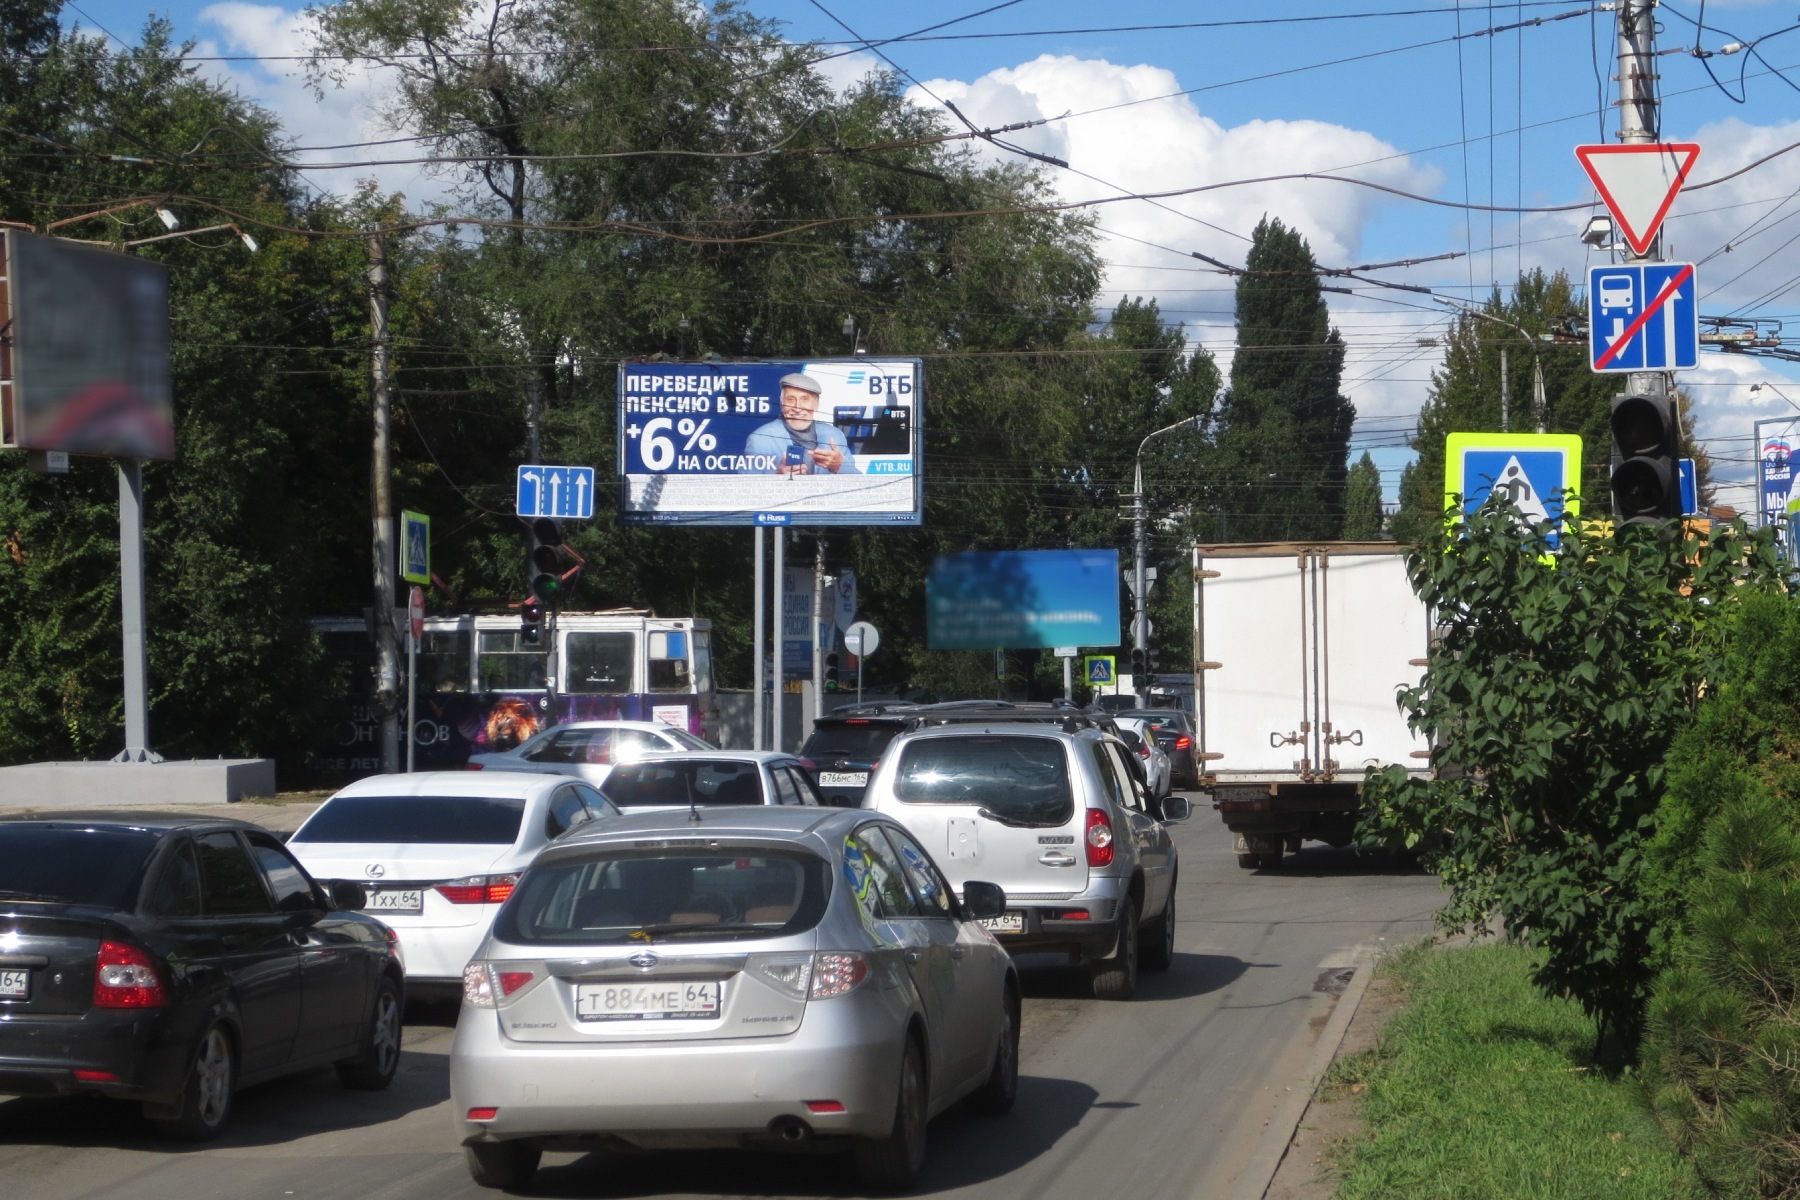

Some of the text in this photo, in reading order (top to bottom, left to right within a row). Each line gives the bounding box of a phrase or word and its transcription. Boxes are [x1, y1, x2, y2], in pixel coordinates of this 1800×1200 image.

[626, 375, 749, 395] ПЕРЕВЕДИТЕ
[868, 375, 912, 394] ВТБ
[626, 396, 770, 413] ПЕНСИЮ В ВТБ
[678, 455, 778, 470] НА ОСТАТОК
[874, 462, 911, 472] VTB.RU
[1766, 492, 1787, 510] МЫ
[784, 595, 809, 614] ЕДИНАЯ
[784, 616, 809, 636] РОССИЯ
[822, 774, 852, 782] В766МС
[402, 892, 418, 903] 64
[1002, 914, 1018, 925] 64
[589, 985, 708, 1010] Т884МЕ 64
